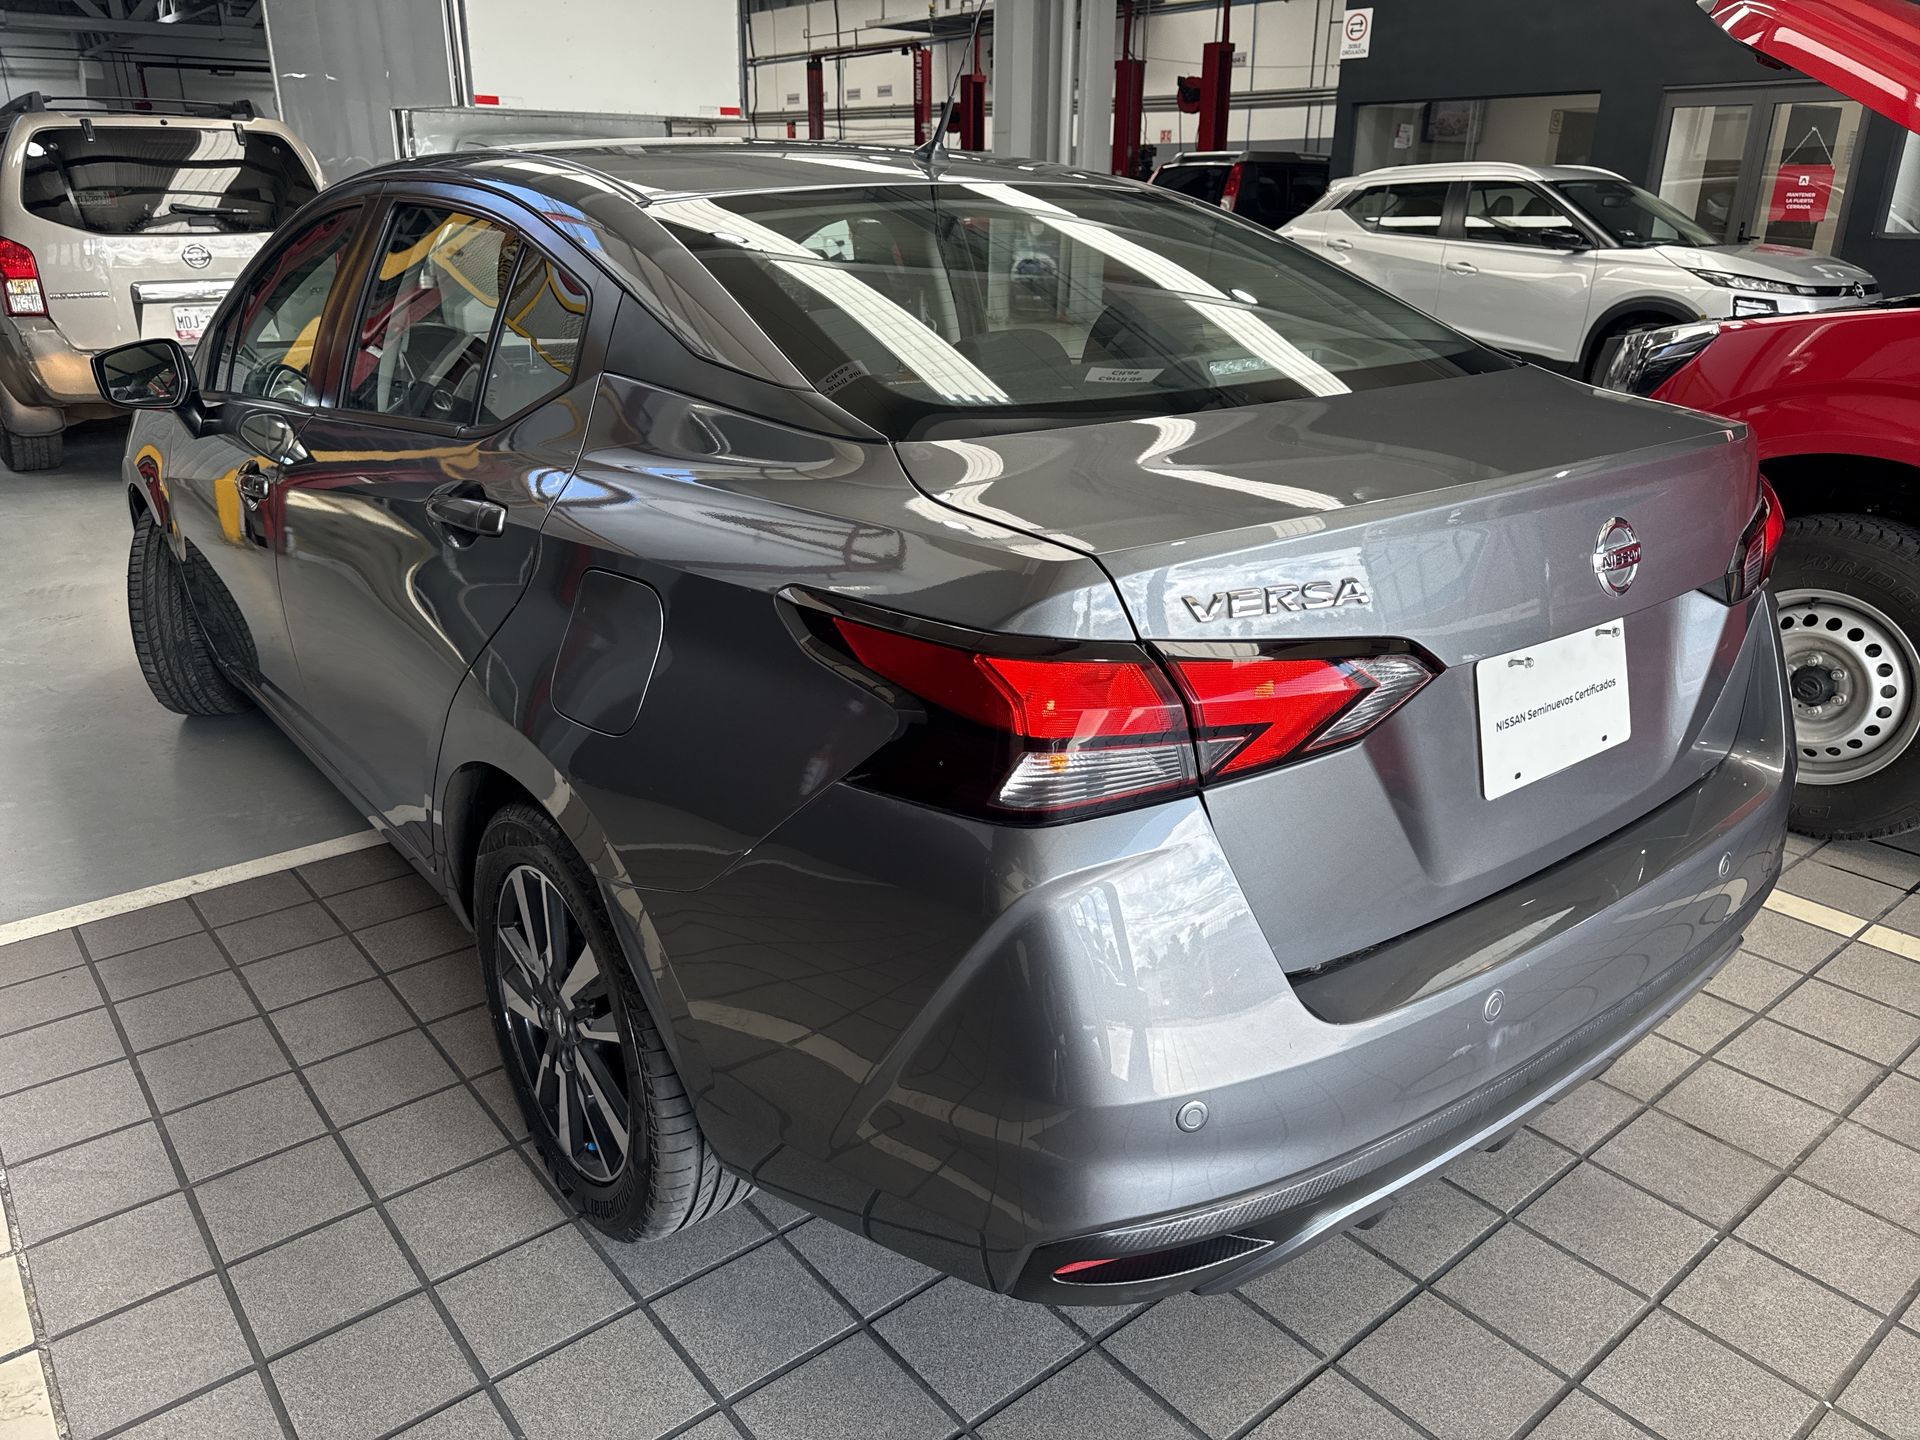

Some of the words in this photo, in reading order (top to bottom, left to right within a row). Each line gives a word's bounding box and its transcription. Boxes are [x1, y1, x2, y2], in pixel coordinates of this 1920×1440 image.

[177, 315, 212, 329] MDJ-
[1181, 577, 1370, 623] VERSA
[1495, 711, 1526, 732] NISSAN
[1527, 694, 1574, 721] Seminuevos
[1574, 677, 1617, 701] Certificados
